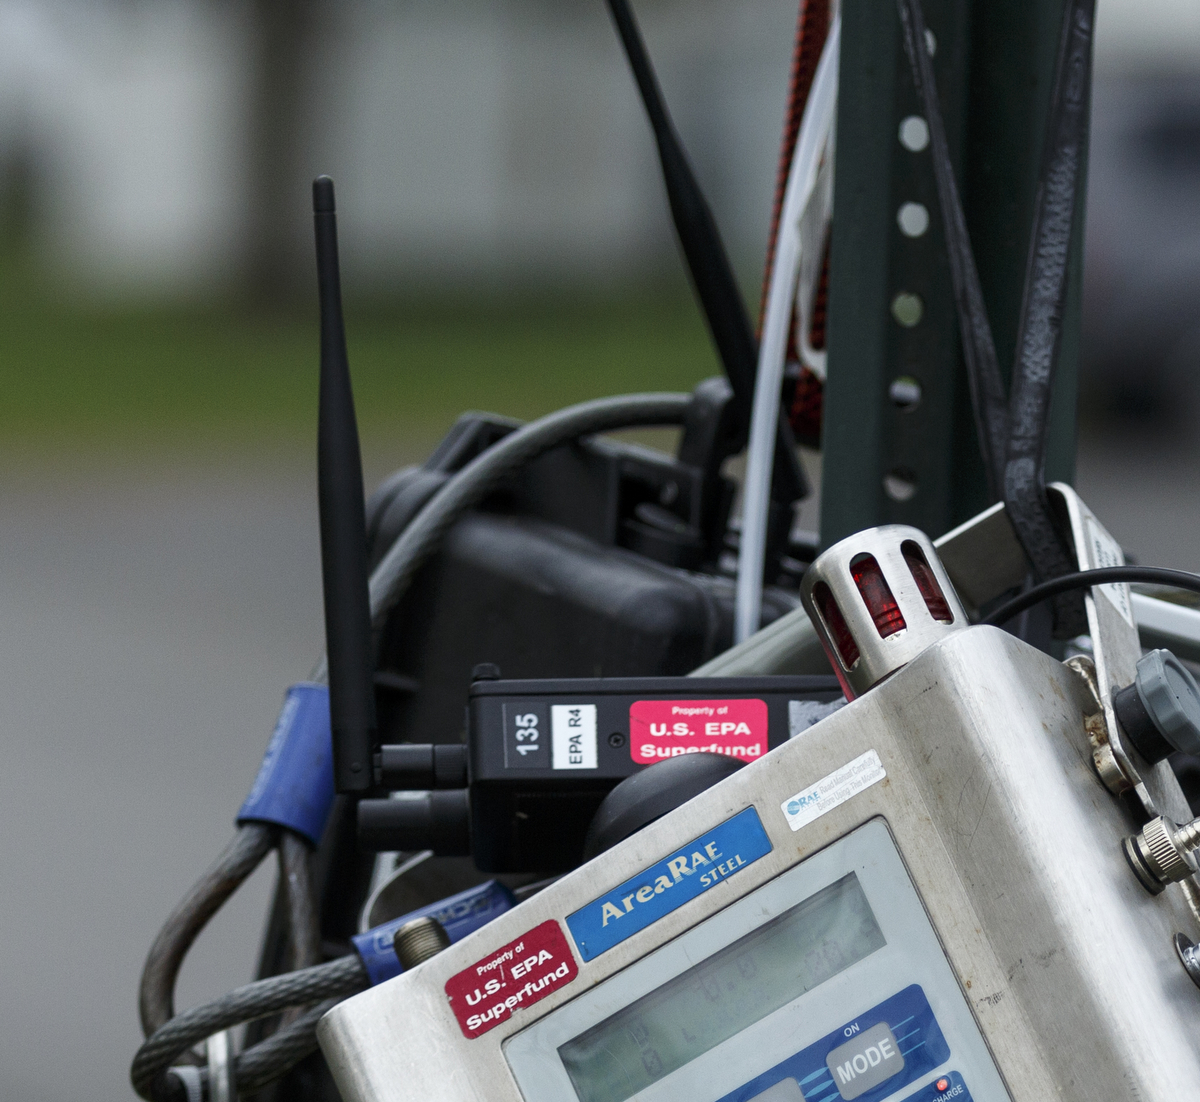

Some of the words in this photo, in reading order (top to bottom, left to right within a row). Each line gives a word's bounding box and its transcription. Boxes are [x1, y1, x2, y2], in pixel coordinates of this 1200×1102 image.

[568, 708, 582, 728] R4
[672, 706, 714, 717] Property
[716, 706, 728, 716] of
[515, 712, 539, 756] 135
[649, 722, 695, 737] U.S.
[704, 722, 751, 736] EPA
[569, 734, 582, 765] EPA
[820, 780, 836, 794] Read
[834, 769, 855, 786] Manual
[852, 756, 876, 776] Carefully
[798, 790, 820, 808] RAE
[816, 796, 836, 811] Before
[834, 786, 851, 802] Using
[600, 840, 724, 928] AreaRAE
[699, 854, 747, 888] STEEL
[476, 950, 514, 976] Property
[514, 942, 525, 954] of
[464, 978, 506, 1006] U.S.
[510, 949, 554, 980] EPA
[466, 962, 570, 1030] Superfund
[842, 1022, 861, 1038] ON
[835, 1038, 896, 1086] MODE
